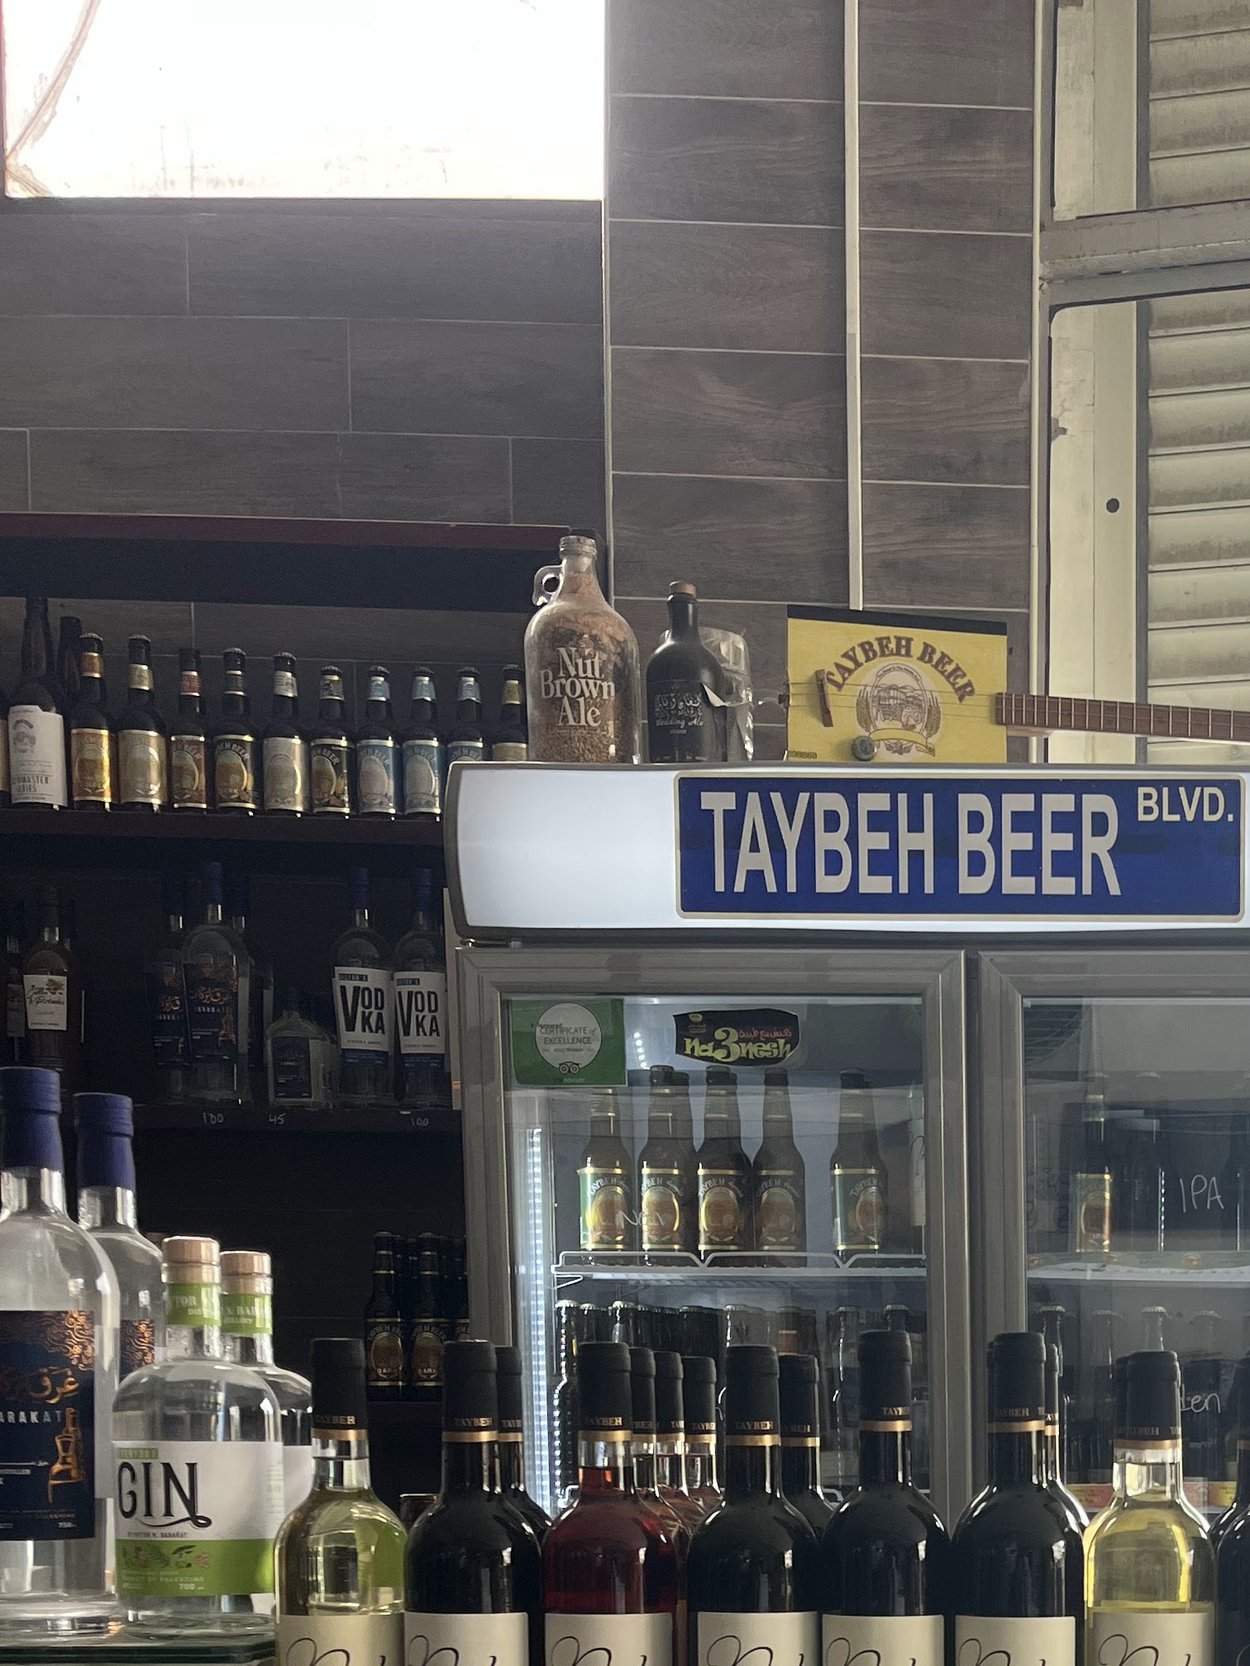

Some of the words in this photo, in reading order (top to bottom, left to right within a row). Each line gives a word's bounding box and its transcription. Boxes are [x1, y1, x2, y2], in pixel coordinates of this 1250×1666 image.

[557, 647, 604, 679] Nut
[826, 635, 914, 692] TAYBEH
[916, 641, 975, 703] BEER
[540, 669, 616, 701] Brown
[557, 696, 601, 728] Ale
[700, 791, 934, 895] TAYBEH
[958, 792, 1122, 896] BEER
[1137, 786, 1234, 823] BLVD.
[540, 1026, 589, 1036] CERTIFICATE
[543, 1036, 592, 1045] EXCELLENCE
[268, 1113, 286, 1126] 45
[1179, 1174, 1225, 1213] IPA
[314, 1415, 355, 1426] TAYBEH
[453, 1416, 494, 1428] TAYBEH
[734, 1420, 773, 1431] TAYBEH
[117, 1461, 213, 1528] GIN
[178, 1583, 196, 1591] 700
